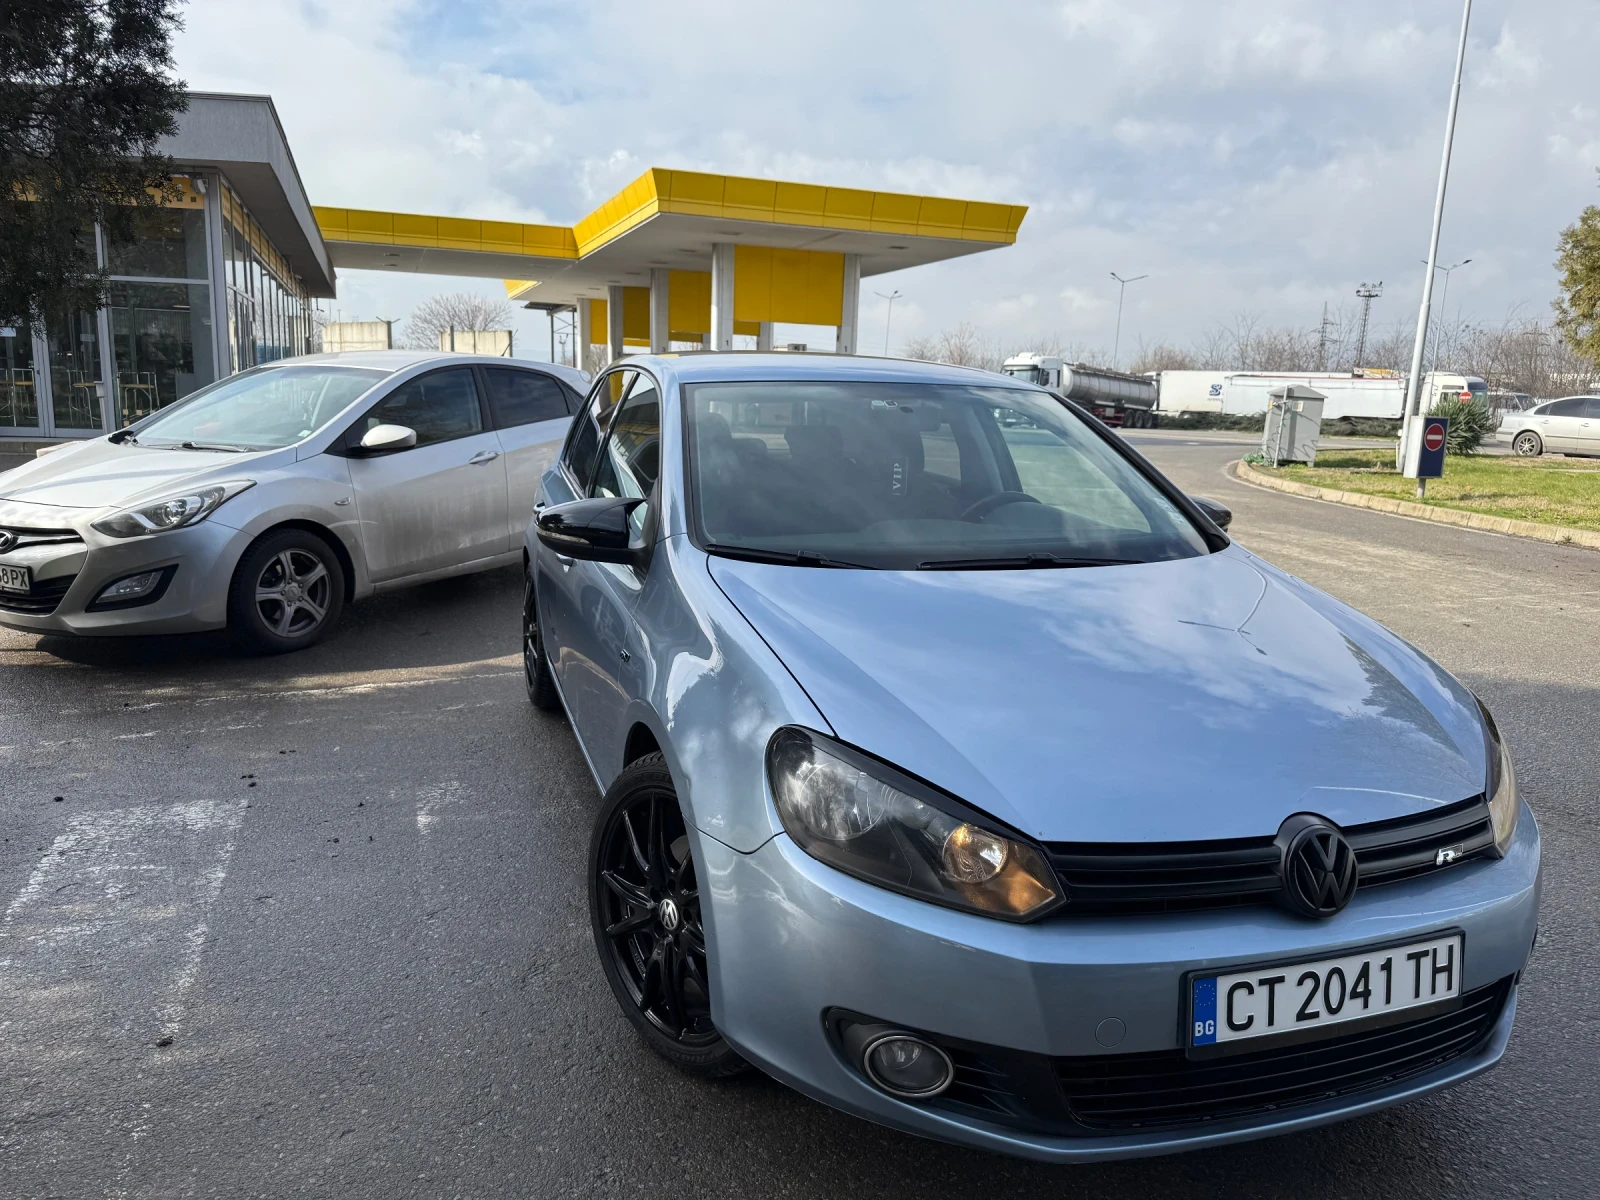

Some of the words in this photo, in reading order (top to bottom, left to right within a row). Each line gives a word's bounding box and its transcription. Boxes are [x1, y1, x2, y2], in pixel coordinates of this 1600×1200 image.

[892, 462, 902, 490] VIP
[0, 567, 28, 588] 8PX
[1226, 974, 1286, 1032] CT
[1295, 956, 1393, 1023] 2041
[1406, 943, 1455, 999] TH
[1194, 1018, 1215, 1037] BG
